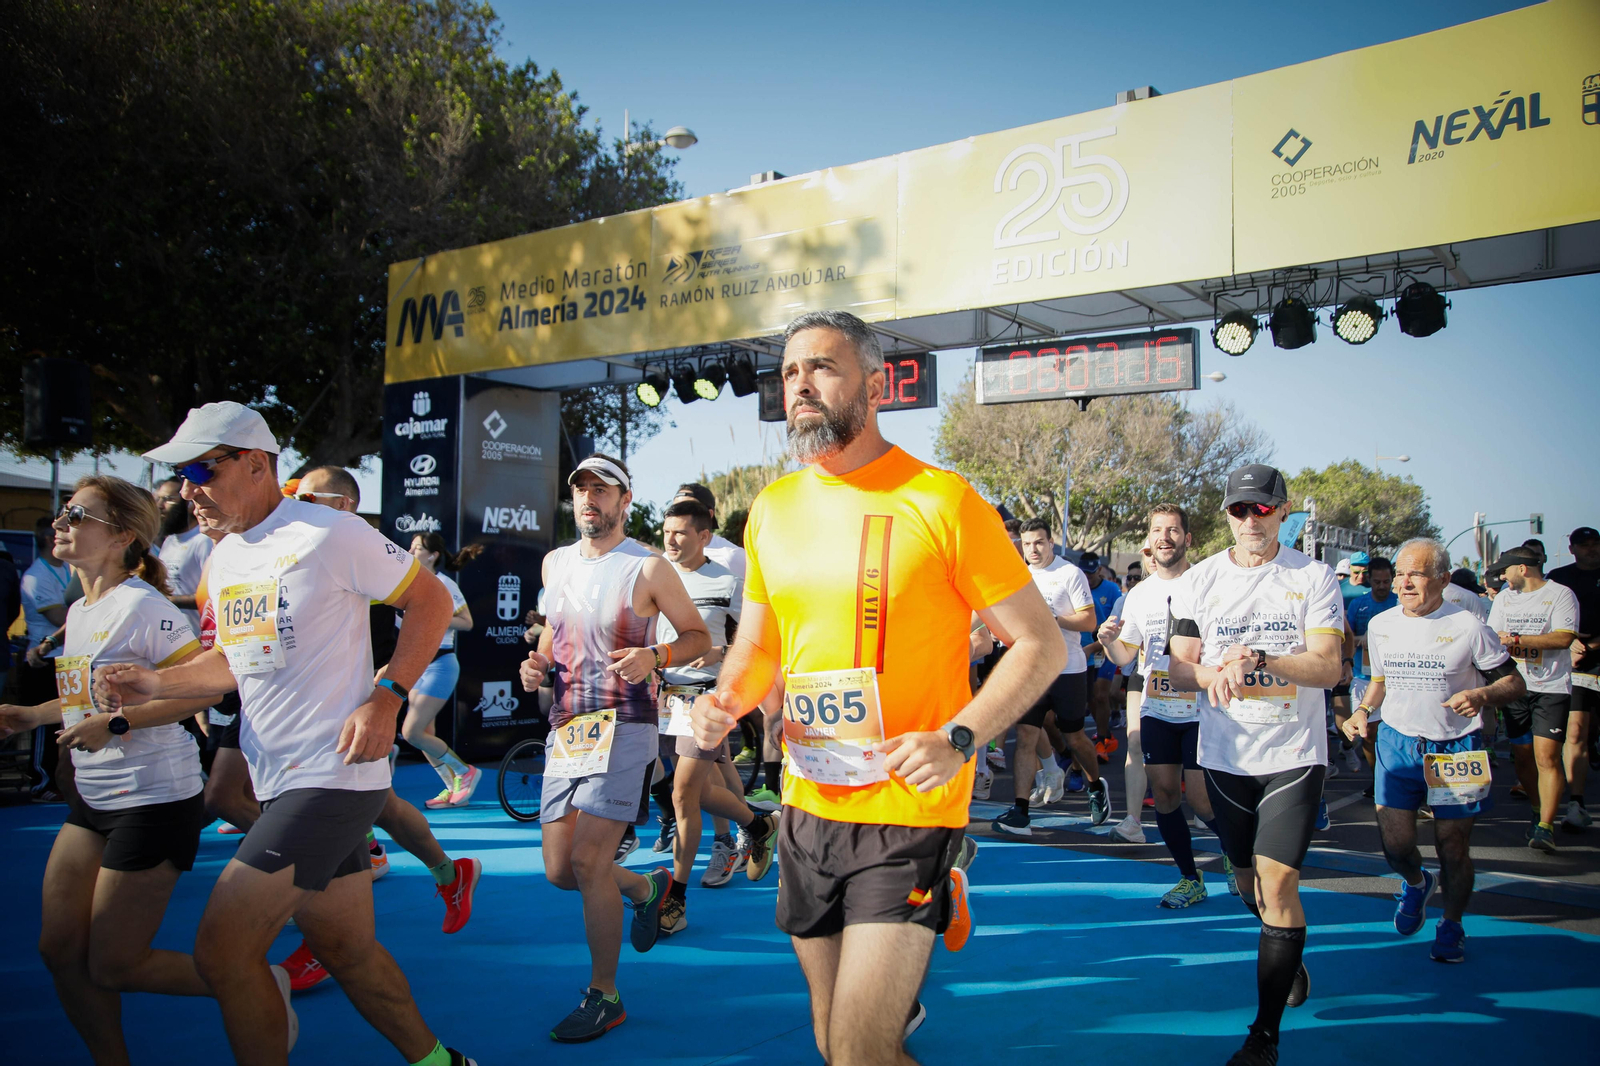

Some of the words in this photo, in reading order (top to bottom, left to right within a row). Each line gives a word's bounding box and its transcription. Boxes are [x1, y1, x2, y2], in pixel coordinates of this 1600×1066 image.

[1418, 150, 1445, 163] 2020
[1271, 156, 1379, 187] COOPERACIÓN
[994, 126, 1130, 250] 25
[1271, 183, 1307, 199] 2005
[993, 238, 1129, 285] EDICIÓN
[500, 275, 555, 302] Medio
[563, 259, 647, 290] Maratón
[660, 285, 714, 308] RAMÓN
[721, 280, 759, 298] RUIZ
[765, 265, 846, 292] ANDÚJAR
[498, 294, 578, 331] Almería
[583, 285, 647, 318] 2024
[395, 417, 448, 440] cajamar
[482, 440, 542, 456] COOPERACIÓN
[482, 450, 503, 461] 2005
[404, 477, 440, 487] HYUNDAI
[223, 594, 268, 627] 1694
[1215, 615, 1248, 625] Medio
[1252, 612, 1297, 621] Maratón
[486, 624, 528, 637] ALMERÍA
[1216, 622, 1261, 636] Almería
[1263, 621, 1298, 632] 2024
[496, 637, 519, 645] CIUDAD
[1383, 652, 1404, 660] Medio
[1407, 652, 1446, 661] Maratón
[1383, 659, 1416, 668] Almería
[1417, 660, 1446, 669] 2024
[785, 690, 867, 726] 1965
[566, 722, 601, 744] 314
[805, 727, 836, 737] JAVIER
[1430, 761, 1483, 777] 1598
